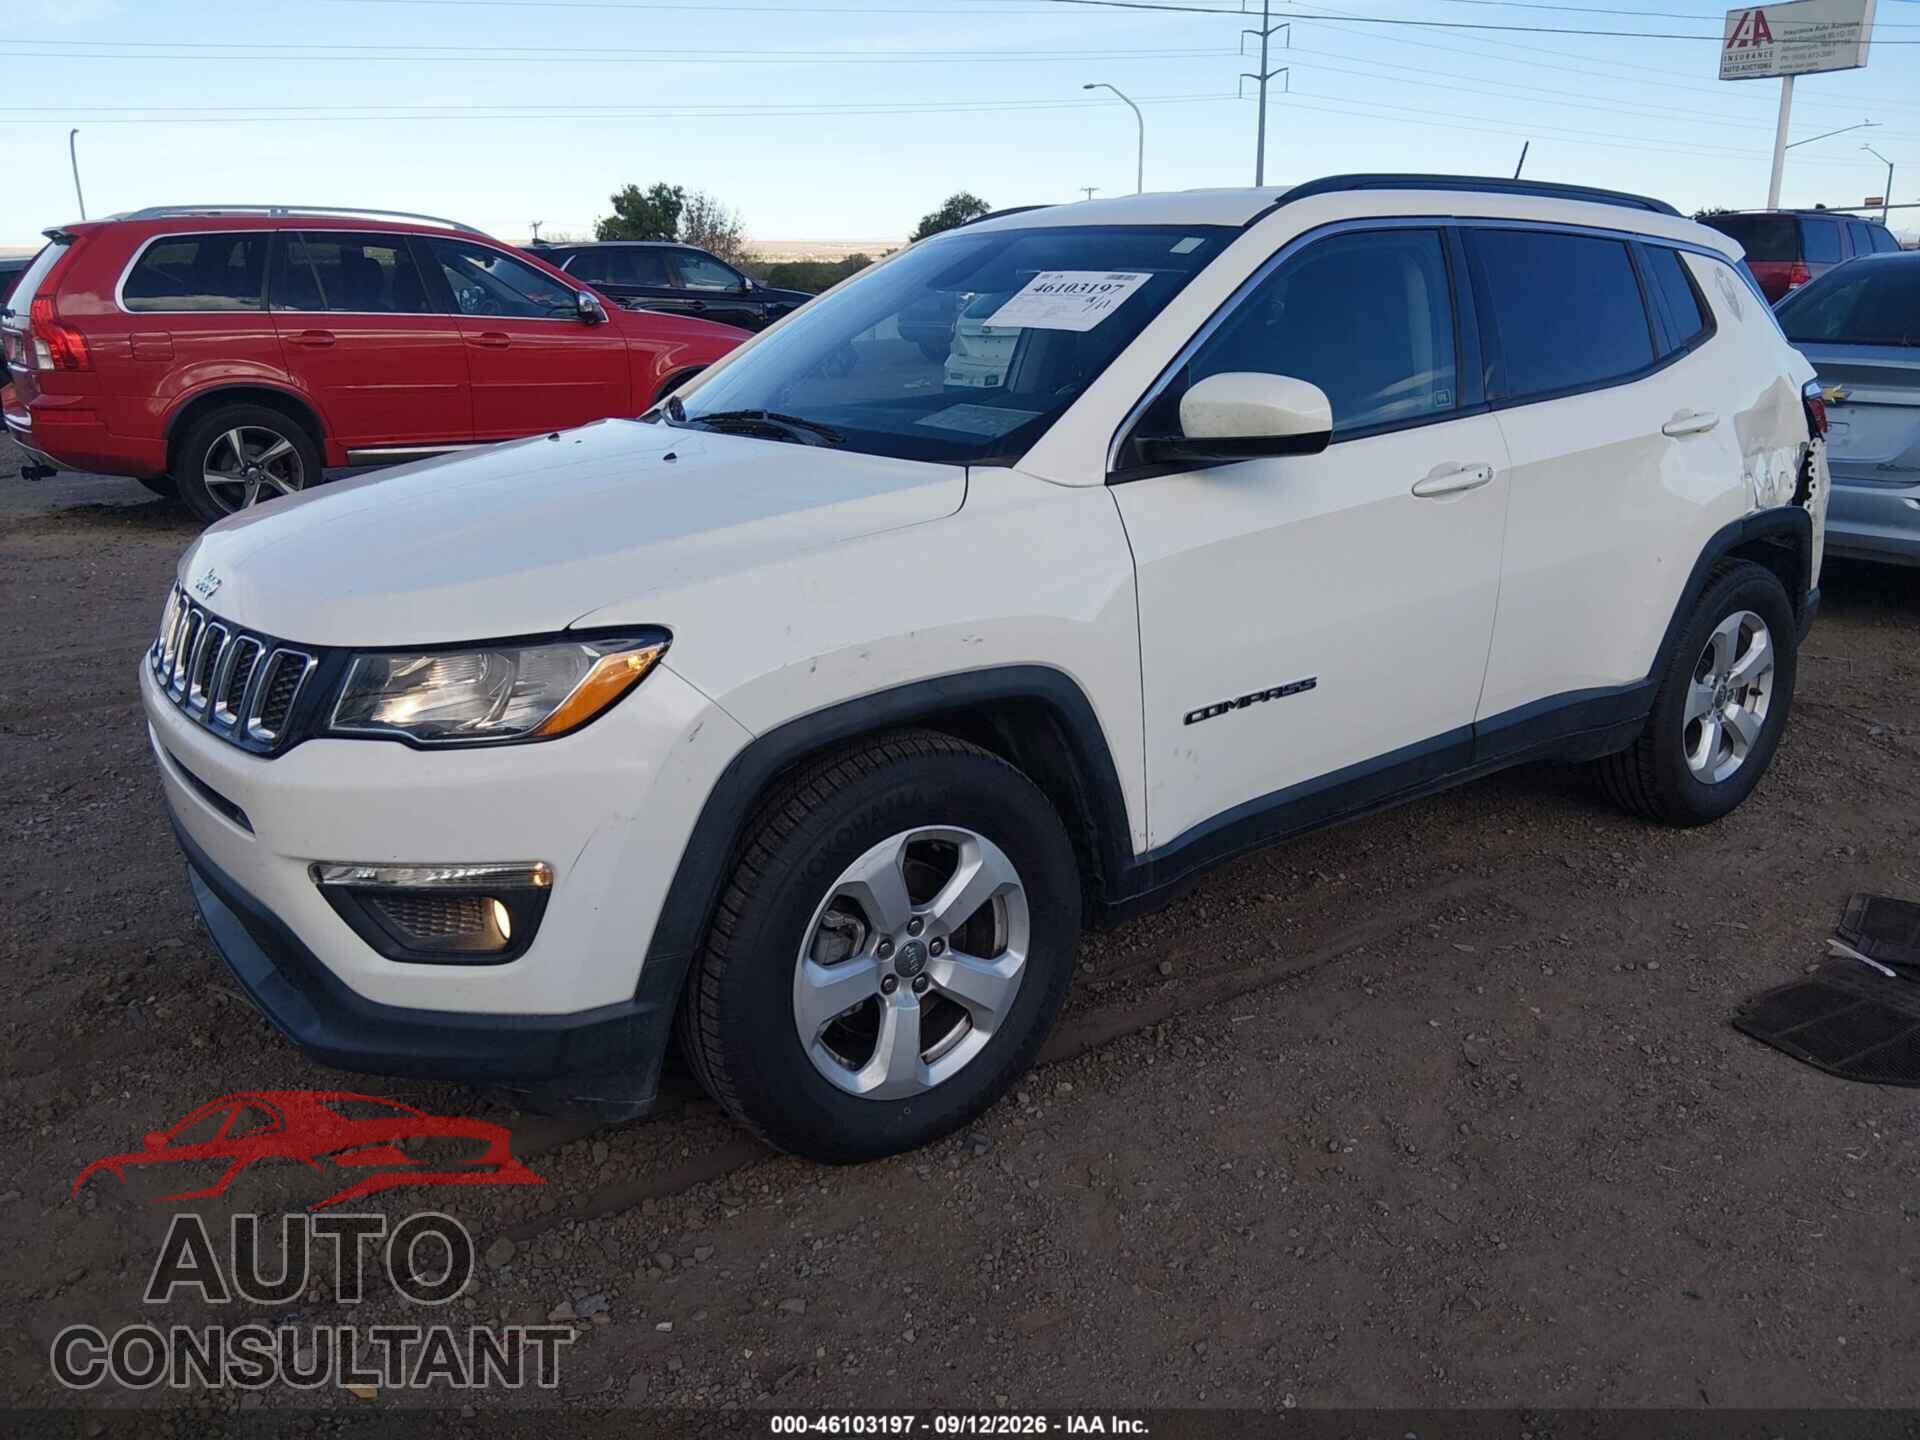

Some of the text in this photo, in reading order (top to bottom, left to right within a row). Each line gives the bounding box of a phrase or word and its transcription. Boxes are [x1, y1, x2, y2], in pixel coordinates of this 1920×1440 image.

[1723, 50, 1774, 62] INSURANCE
[1723, 64, 1740, 73] AUTO
[1742, 62, 1773, 71] AUCTIONS
[1033, 282, 1126, 295] 46103197
[1184, 676, 1318, 726] COMPASS
